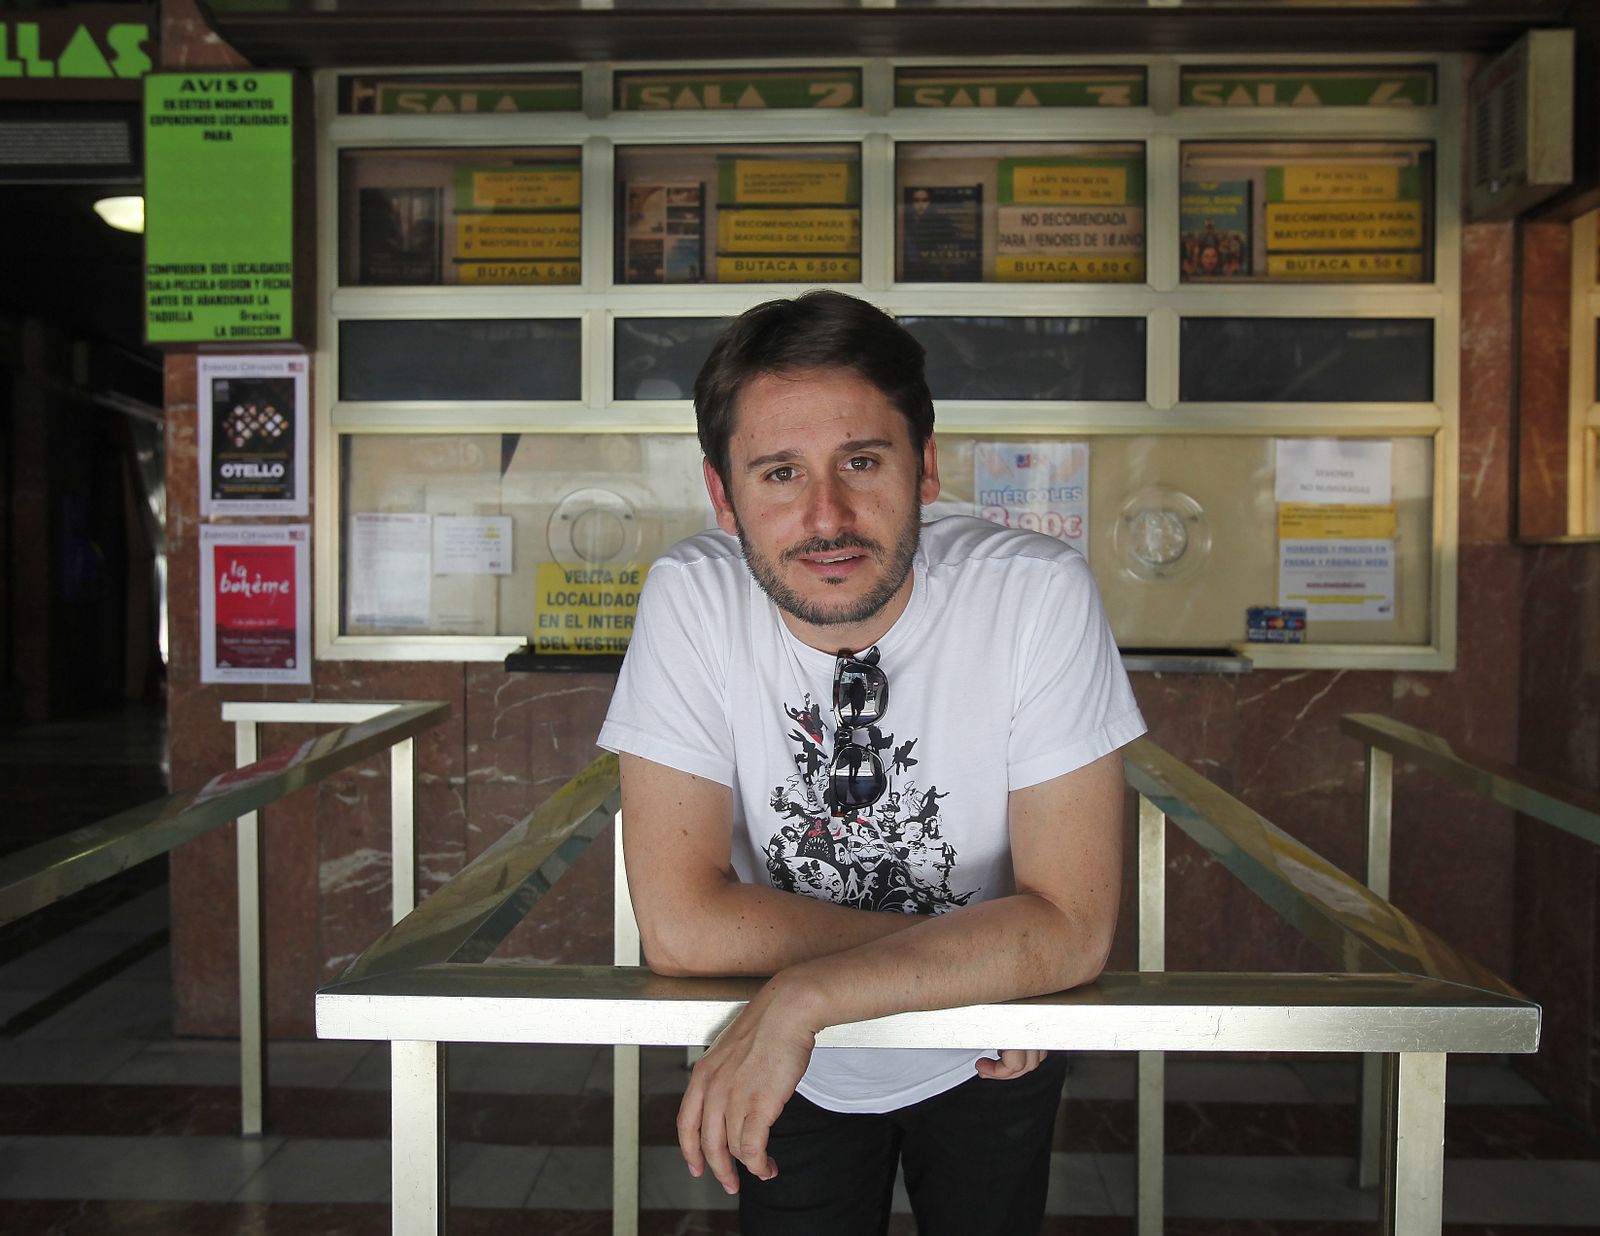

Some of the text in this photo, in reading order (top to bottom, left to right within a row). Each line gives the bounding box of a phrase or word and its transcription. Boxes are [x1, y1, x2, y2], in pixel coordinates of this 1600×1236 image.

[180, 78, 258, 93] AVISO
[639, 82, 854, 110] SALA 2
[215, 98, 274, 110] MOMENTOS
[220, 114, 288, 126] LOCALIDADES
[203, 131, 232, 142] PARA
[1021, 212, 1128, 226] NO RECOMENDADA
[1273, 211, 1415, 223] RECOMENDADA PARA
[559, 225, 580, 234] PAR
[735, 219, 844, 229] RECOMENDADA PARA
[734, 232, 845, 242] MAYORES DE 12 AÑOS
[1273, 229, 1337, 239] MAYORES
[1339, 228, 1356, 239] DE
[1378, 227, 1416, 238] AÑOS
[1084, 233, 1098, 247] DE
[232, 263, 290, 274] LOCALIDADES
[735, 260, 799, 272] BUTACA
[841, 262, 851, 273] €
[1014, 262, 1079, 273] BUTACA
[1123, 263, 1132, 273] €
[1285, 259, 1350, 271] BUTACA
[1395, 258, 1405, 268] €
[477, 266, 540, 278] BUTACA
[151, 294, 269, 306] ANTES DE ABANDONAR LA
[150, 310, 280, 323] TAQUILLA Gracias
[214, 326, 226, 336] LA
[220, 463, 286, 479] OTELLO
[1315, 469, 1354, 479] SESIONES
[980, 484, 1083, 506] MIÉRCOLES
[1299, 484, 1370, 495] NO NUMERADAS
[1286, 546, 1329, 554] HORARIOS
[231, 560, 247, 576] la
[564, 570, 640, 585] VENTA DE
[220, 570, 290, 598] bohème
[538, 614, 634, 630] EN EL INTER
[540, 636, 571, 650] DEL
